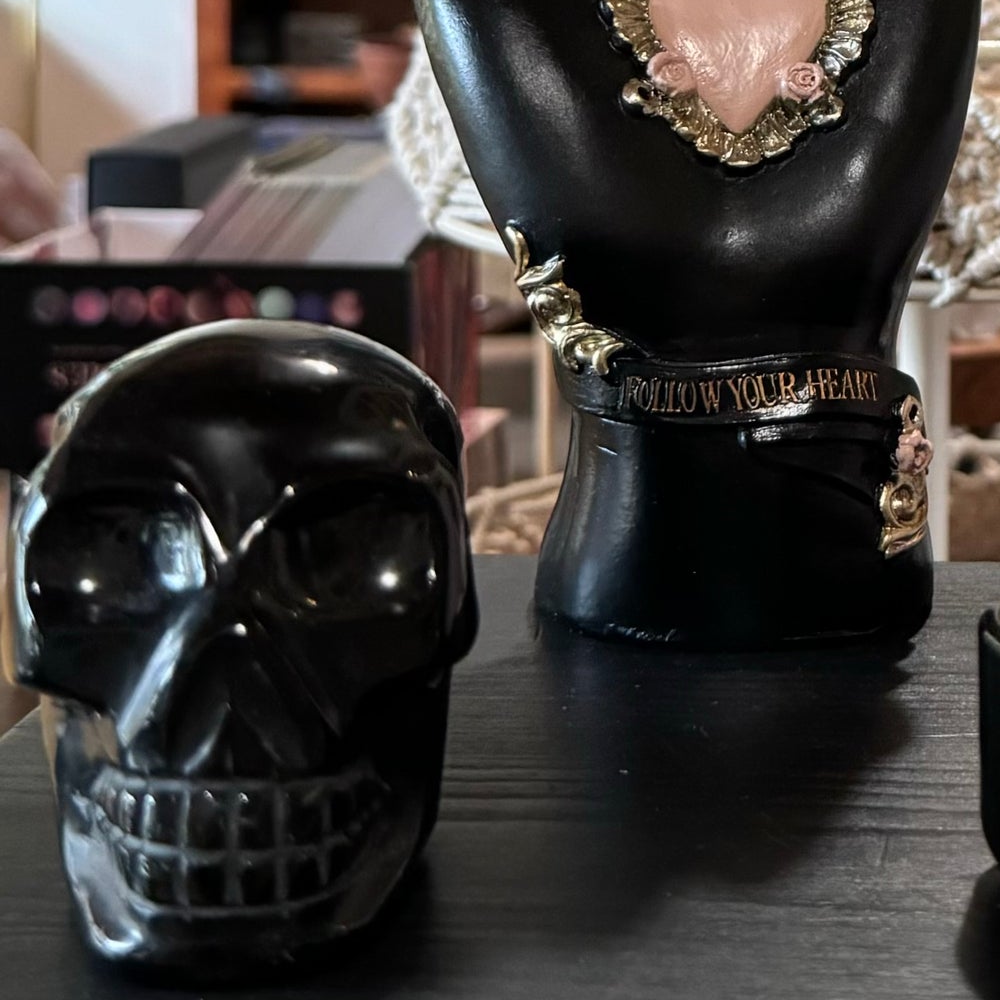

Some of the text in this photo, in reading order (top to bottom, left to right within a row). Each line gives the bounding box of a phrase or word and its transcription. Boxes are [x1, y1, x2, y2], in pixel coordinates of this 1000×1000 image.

[622, 368, 879, 414] FOLLOW YOUR HEART
